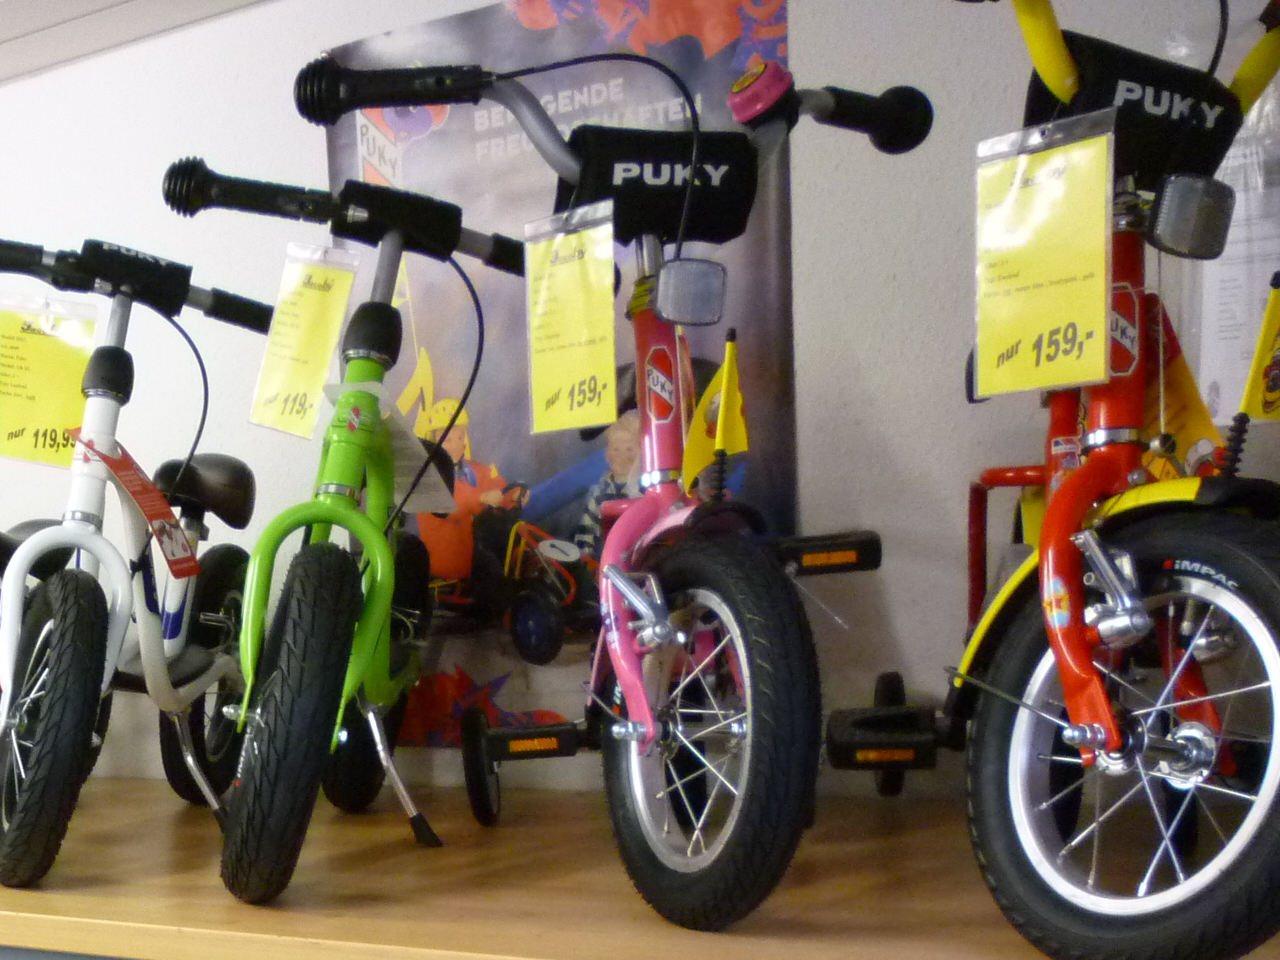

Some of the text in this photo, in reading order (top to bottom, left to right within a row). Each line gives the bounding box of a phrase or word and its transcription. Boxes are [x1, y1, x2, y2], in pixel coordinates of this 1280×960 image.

[1114, 79, 1224, 129] PUKY
[360, 124, 398, 179] PUKY
[612, 163, 729, 187] PUKY
[996, 321, 1095, 369] nur 159,-
[281, 392, 313, 420] 119,-
[568, 375, 608, 411] 159,-
[7, 427, 26, 441] nur
